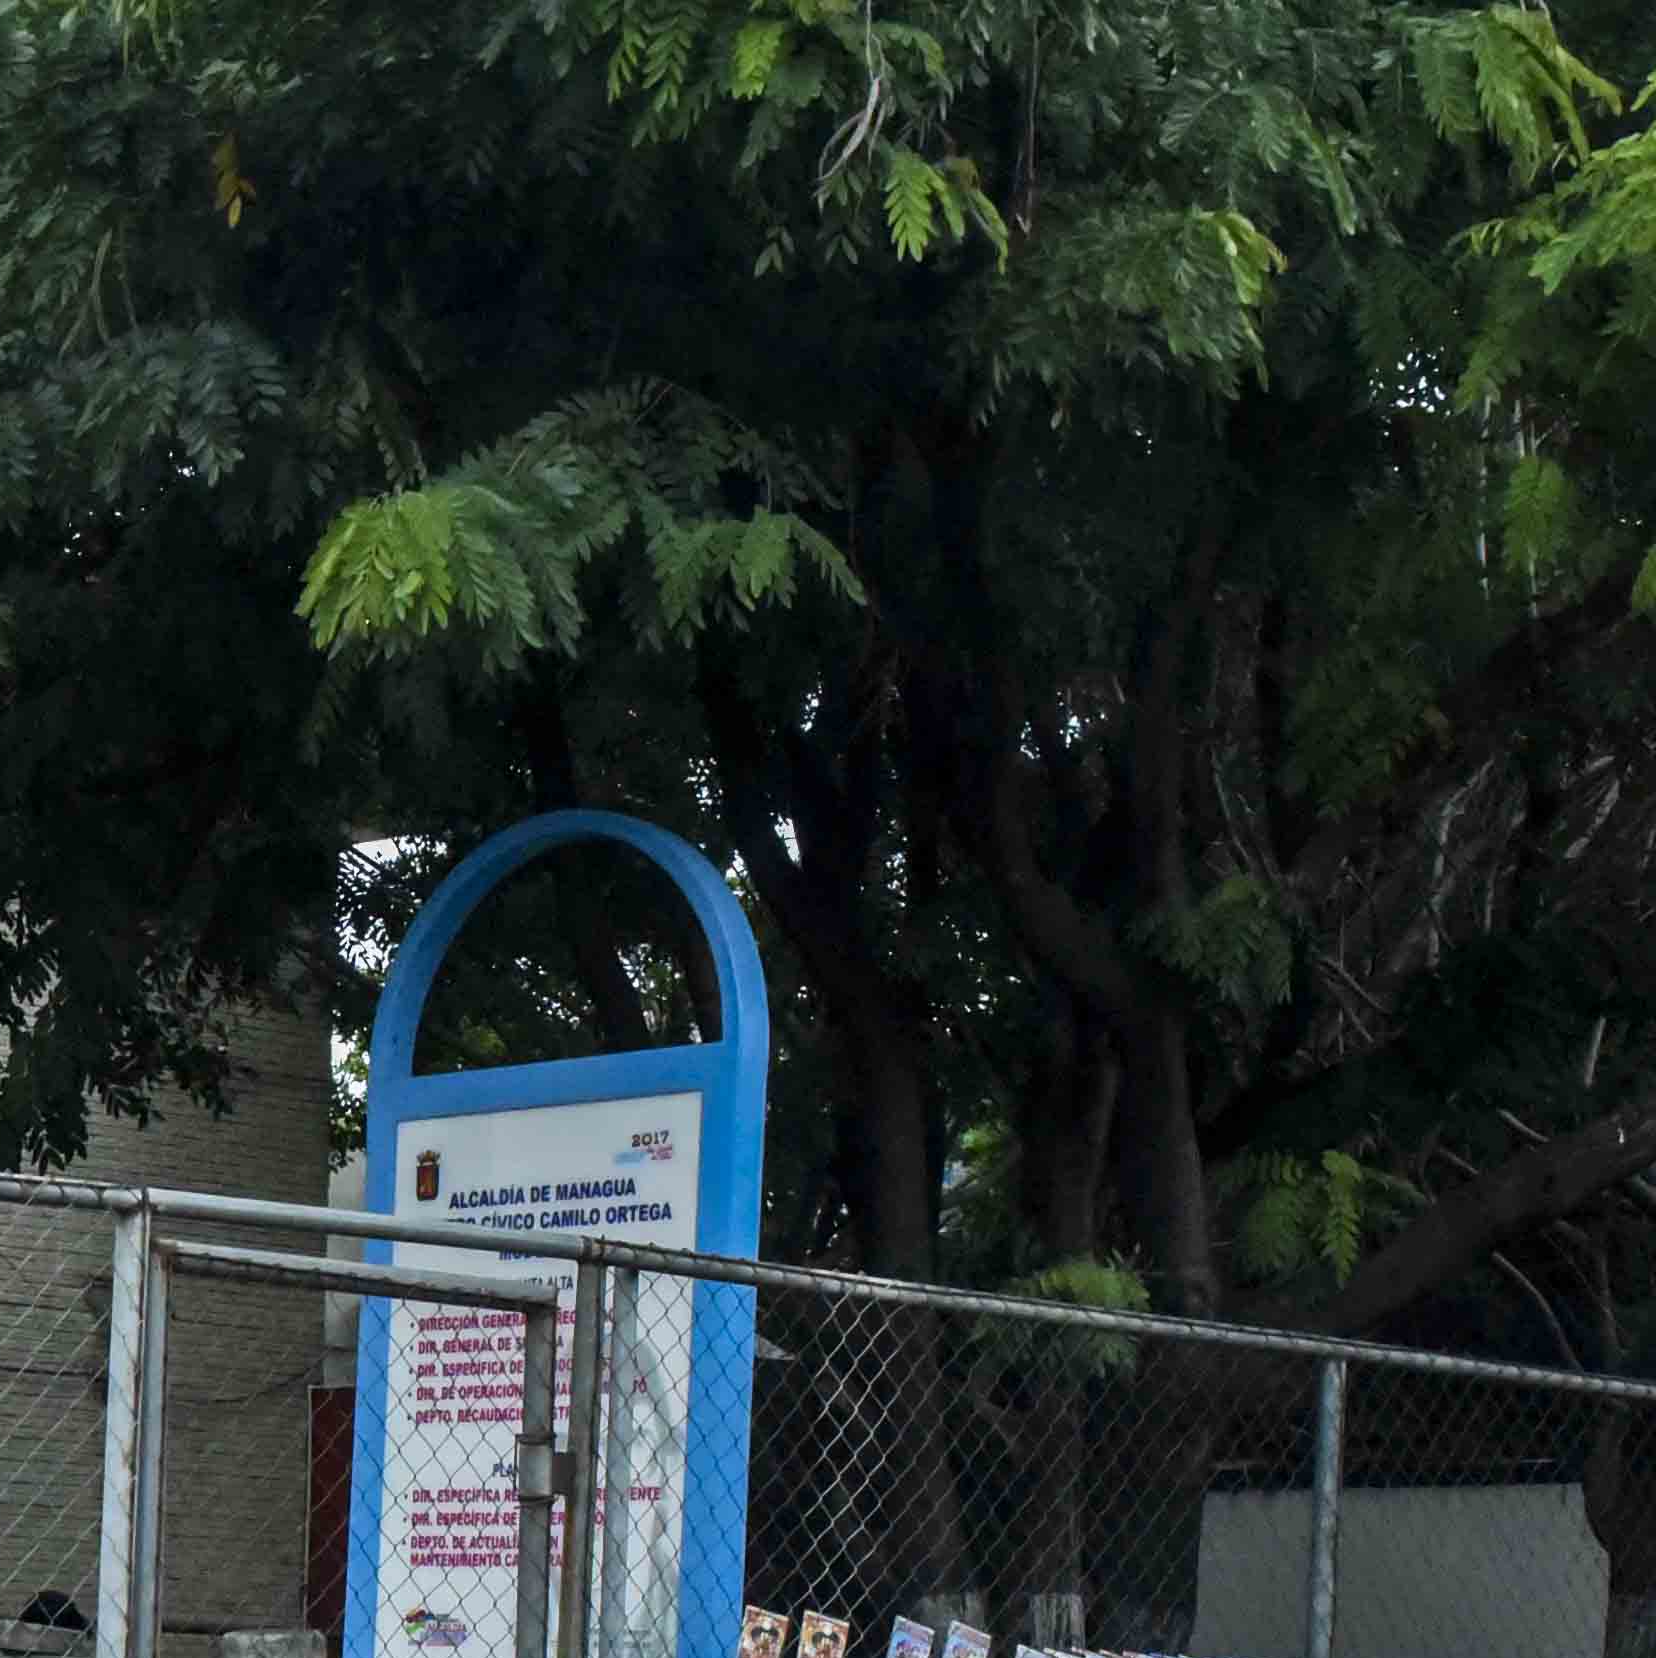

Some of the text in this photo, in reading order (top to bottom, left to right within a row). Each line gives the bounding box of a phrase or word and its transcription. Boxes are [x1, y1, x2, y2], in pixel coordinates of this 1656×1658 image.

[631, 1130, 670, 1147] 2017
[449, 1178, 636, 1209] ALCALDÍA DE MANAGUA
[540, 1207, 601, 1229] CAMILO
[605, 1202, 672, 1224] ORTEGA
[443, 1338, 494, 1353] GENERAL
[497, 1337, 512, 1351] DE
[510, 1360, 524, 1375] DE
[441, 1386, 455, 1399] DE
[503, 1510, 517, 1525] DE
[452, 1535, 464, 1549] DE
[410, 1552, 501, 1567] MANTENIMIENTO
